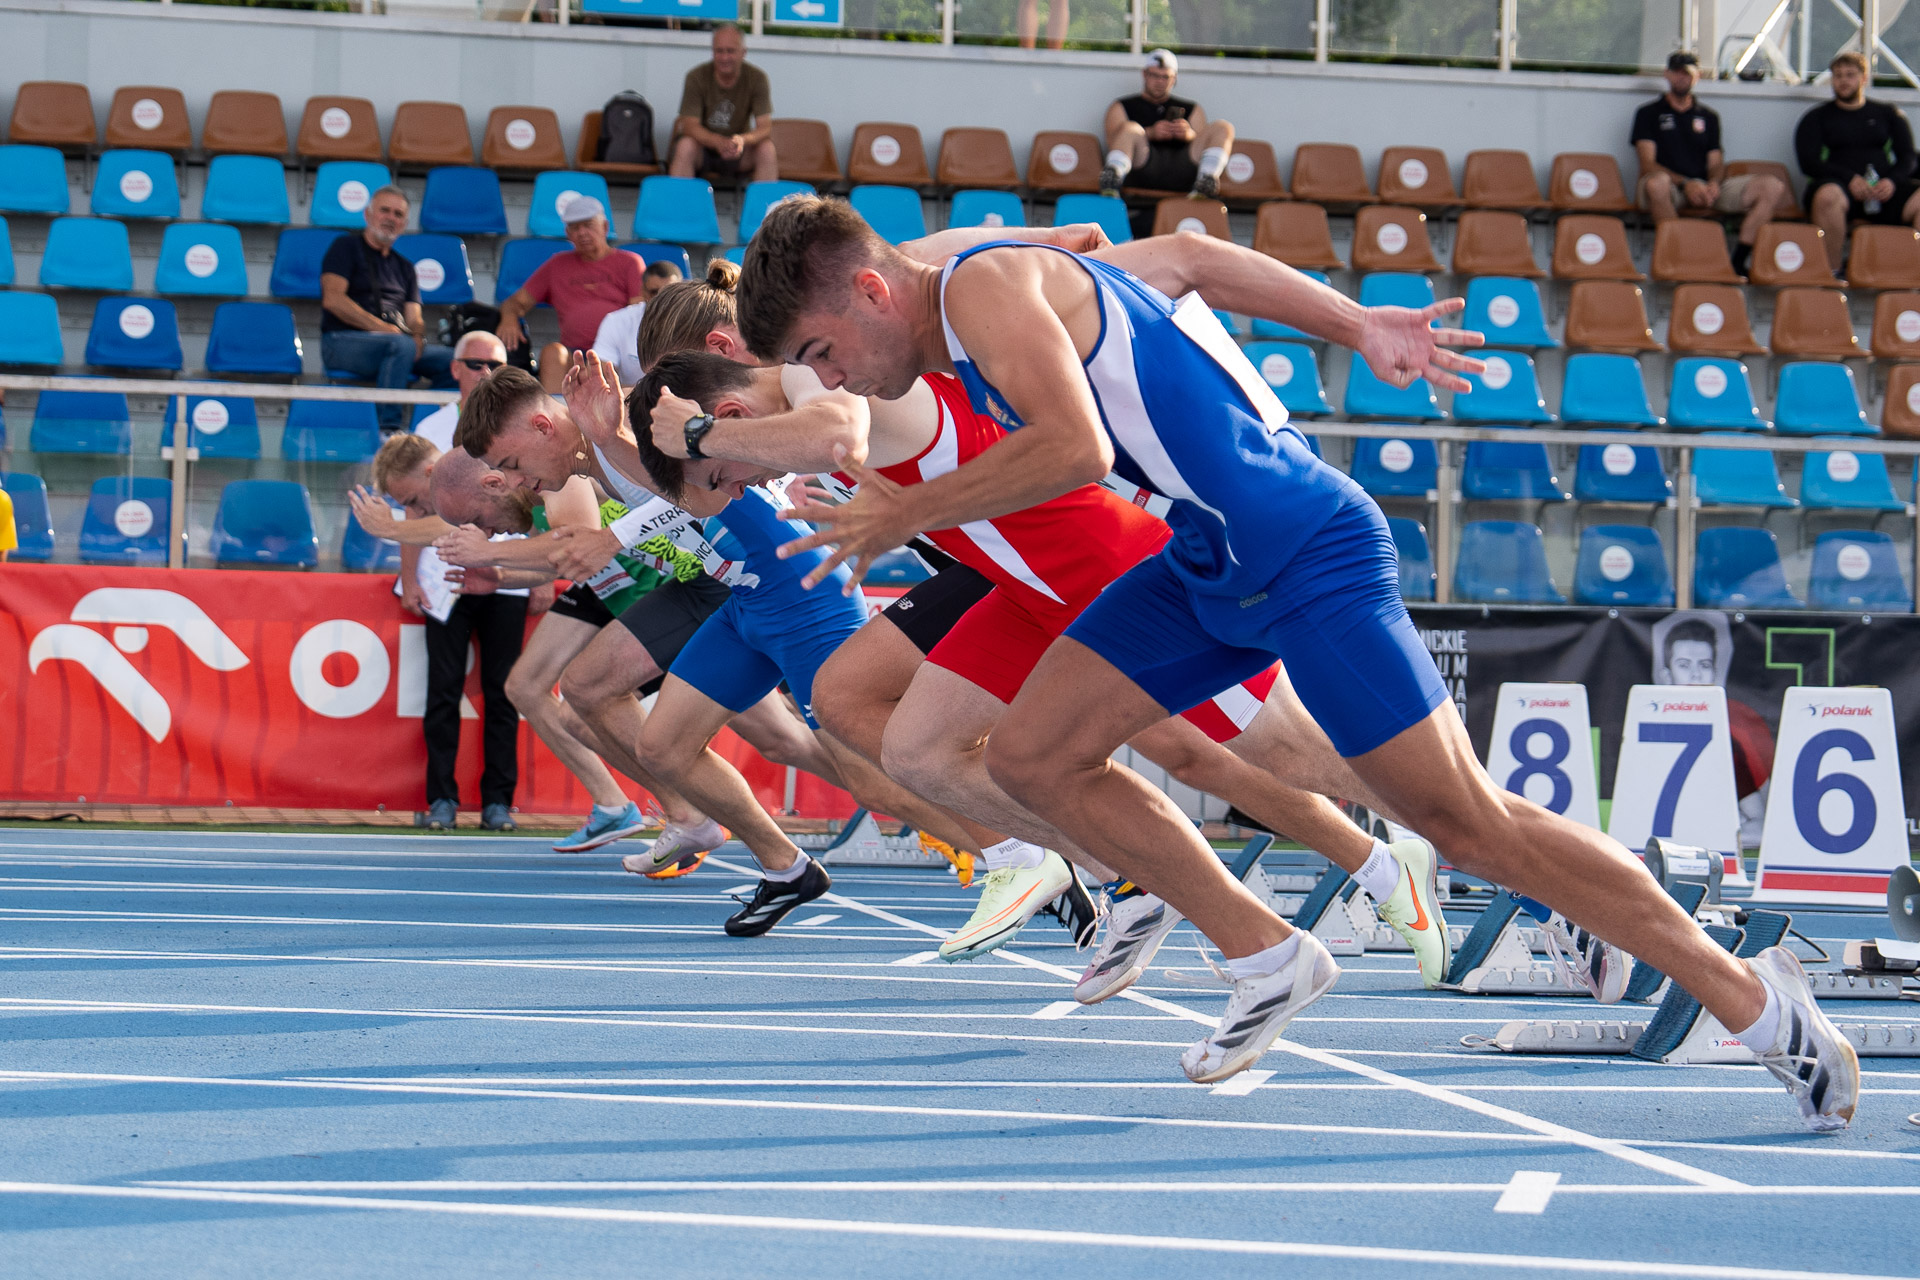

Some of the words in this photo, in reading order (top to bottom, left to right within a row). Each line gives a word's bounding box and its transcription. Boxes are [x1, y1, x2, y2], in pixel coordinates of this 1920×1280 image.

[1437, 654, 1468, 678] UM
[1662, 701, 1709, 713] polanik
[1821, 704, 1873, 718] polanik
[1506, 718, 1573, 816] 8
[1637, 722, 1713, 838] 7
[1792, 728, 1877, 855] 6
